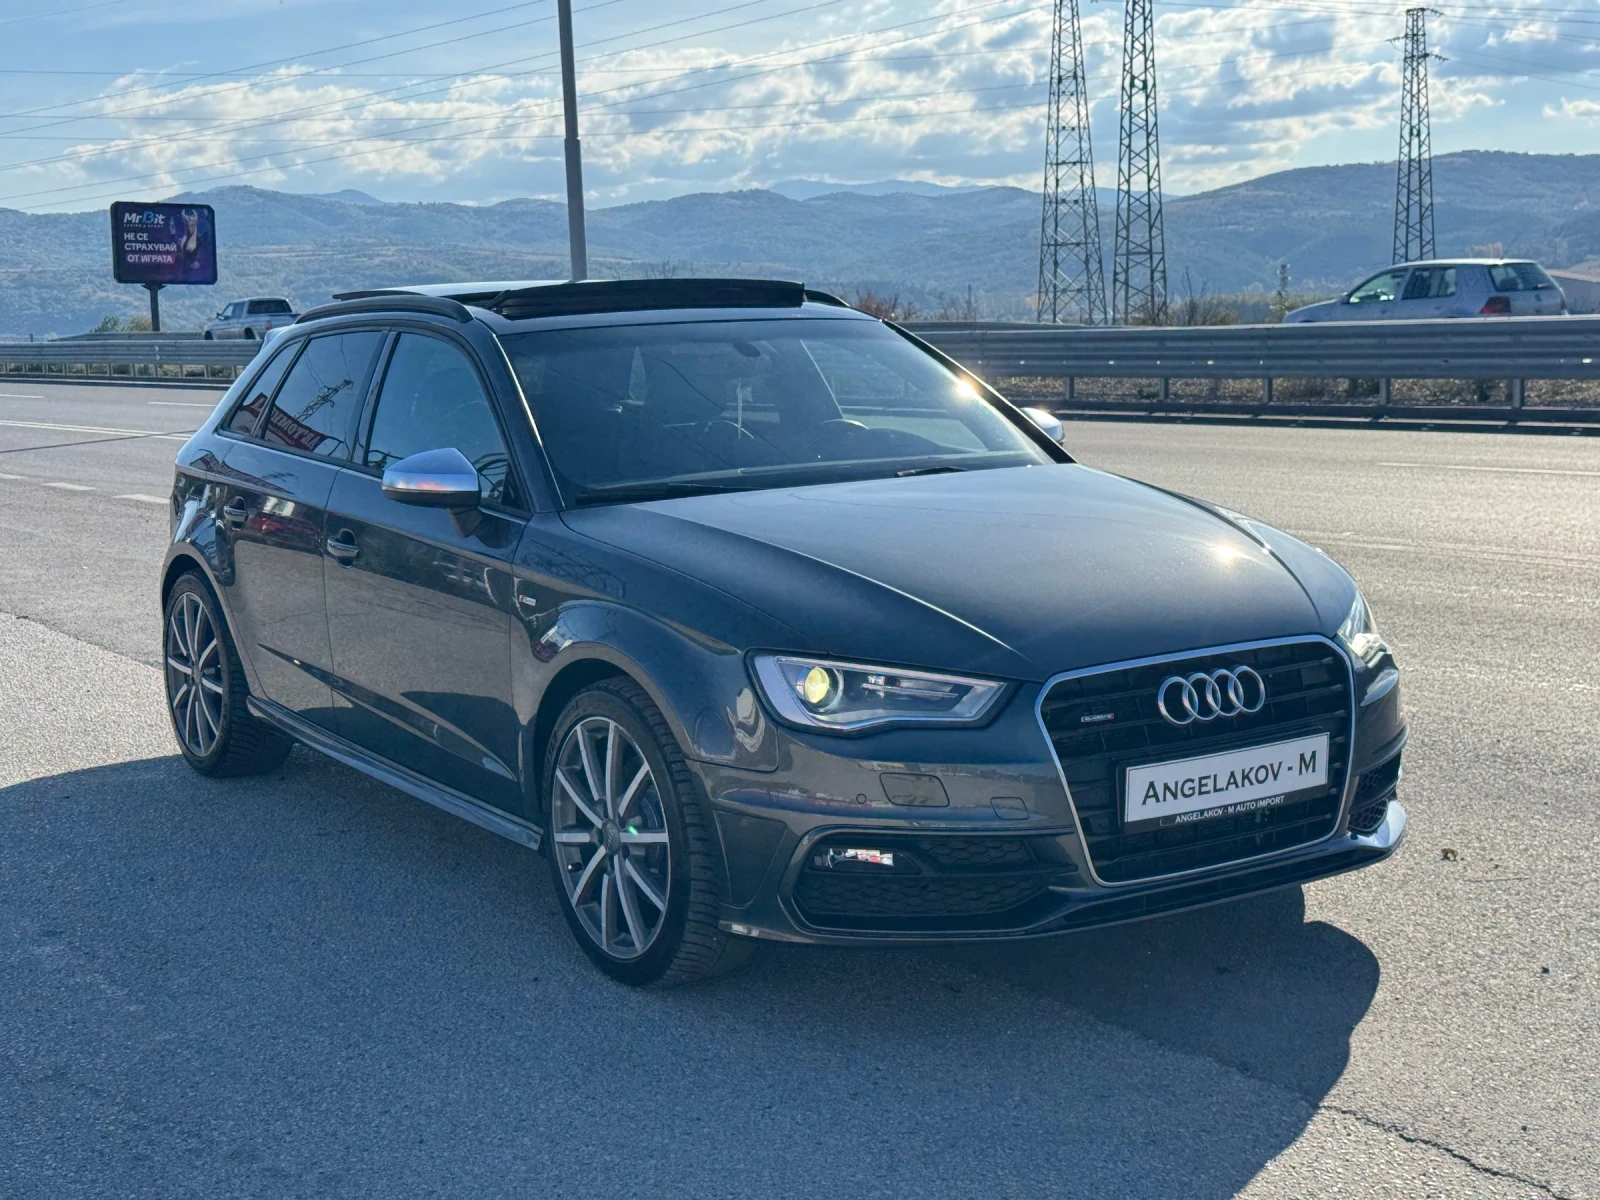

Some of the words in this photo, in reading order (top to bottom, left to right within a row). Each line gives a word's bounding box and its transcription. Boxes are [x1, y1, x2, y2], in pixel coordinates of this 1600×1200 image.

[124, 211, 165, 224] MrBit
[124, 232, 136, 240] НЕ
[137, 232, 149, 240] СЕ
[124, 242, 177, 252] СТРАХУВАЙ
[127, 254, 139, 263] ОТ
[141, 254, 173, 263] ИГРАТА
[1298, 750, 1318, 776] M
[1175, 808, 1224, 824] ANGELAKOV
[1227, 805, 1235, 814] M
[1235, 802, 1256, 813] AUTO
[1256, 796, 1285, 809] IMPORT
